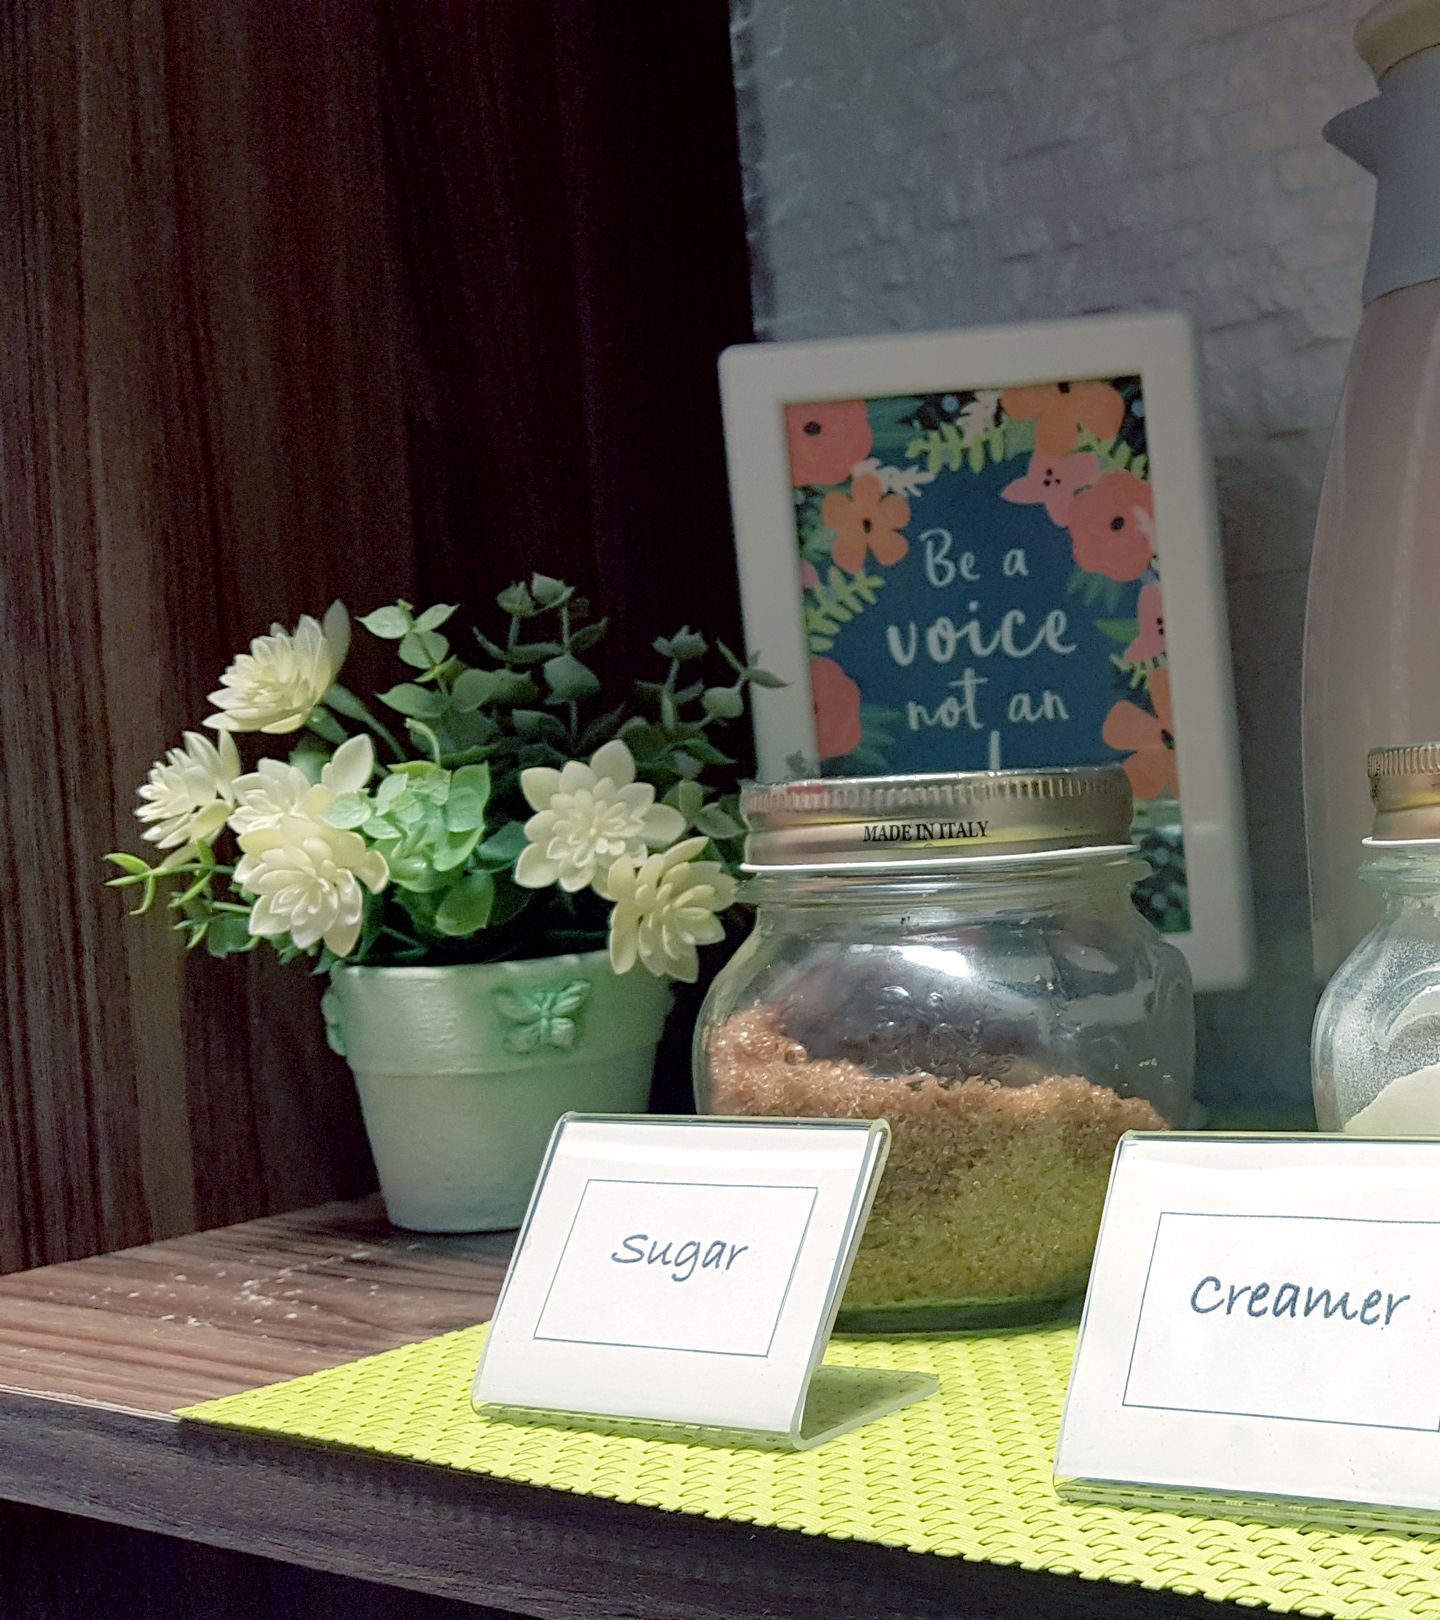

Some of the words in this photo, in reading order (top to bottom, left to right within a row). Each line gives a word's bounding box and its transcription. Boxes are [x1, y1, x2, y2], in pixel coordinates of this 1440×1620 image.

[919, 528, 981, 588] Be
[1003, 549, 1030, 577] a
[886, 600, 1077, 666] voice
[907, 667, 989, 730] not
[1008, 690, 1070, 723] an
[863, 824, 912, 841] MADE
[915, 823, 934, 840] IN
[939, 821, 989, 839] ITALY
[611, 1234, 749, 1282] Sugar
[1190, 1275, 1411, 1326] Creamer
